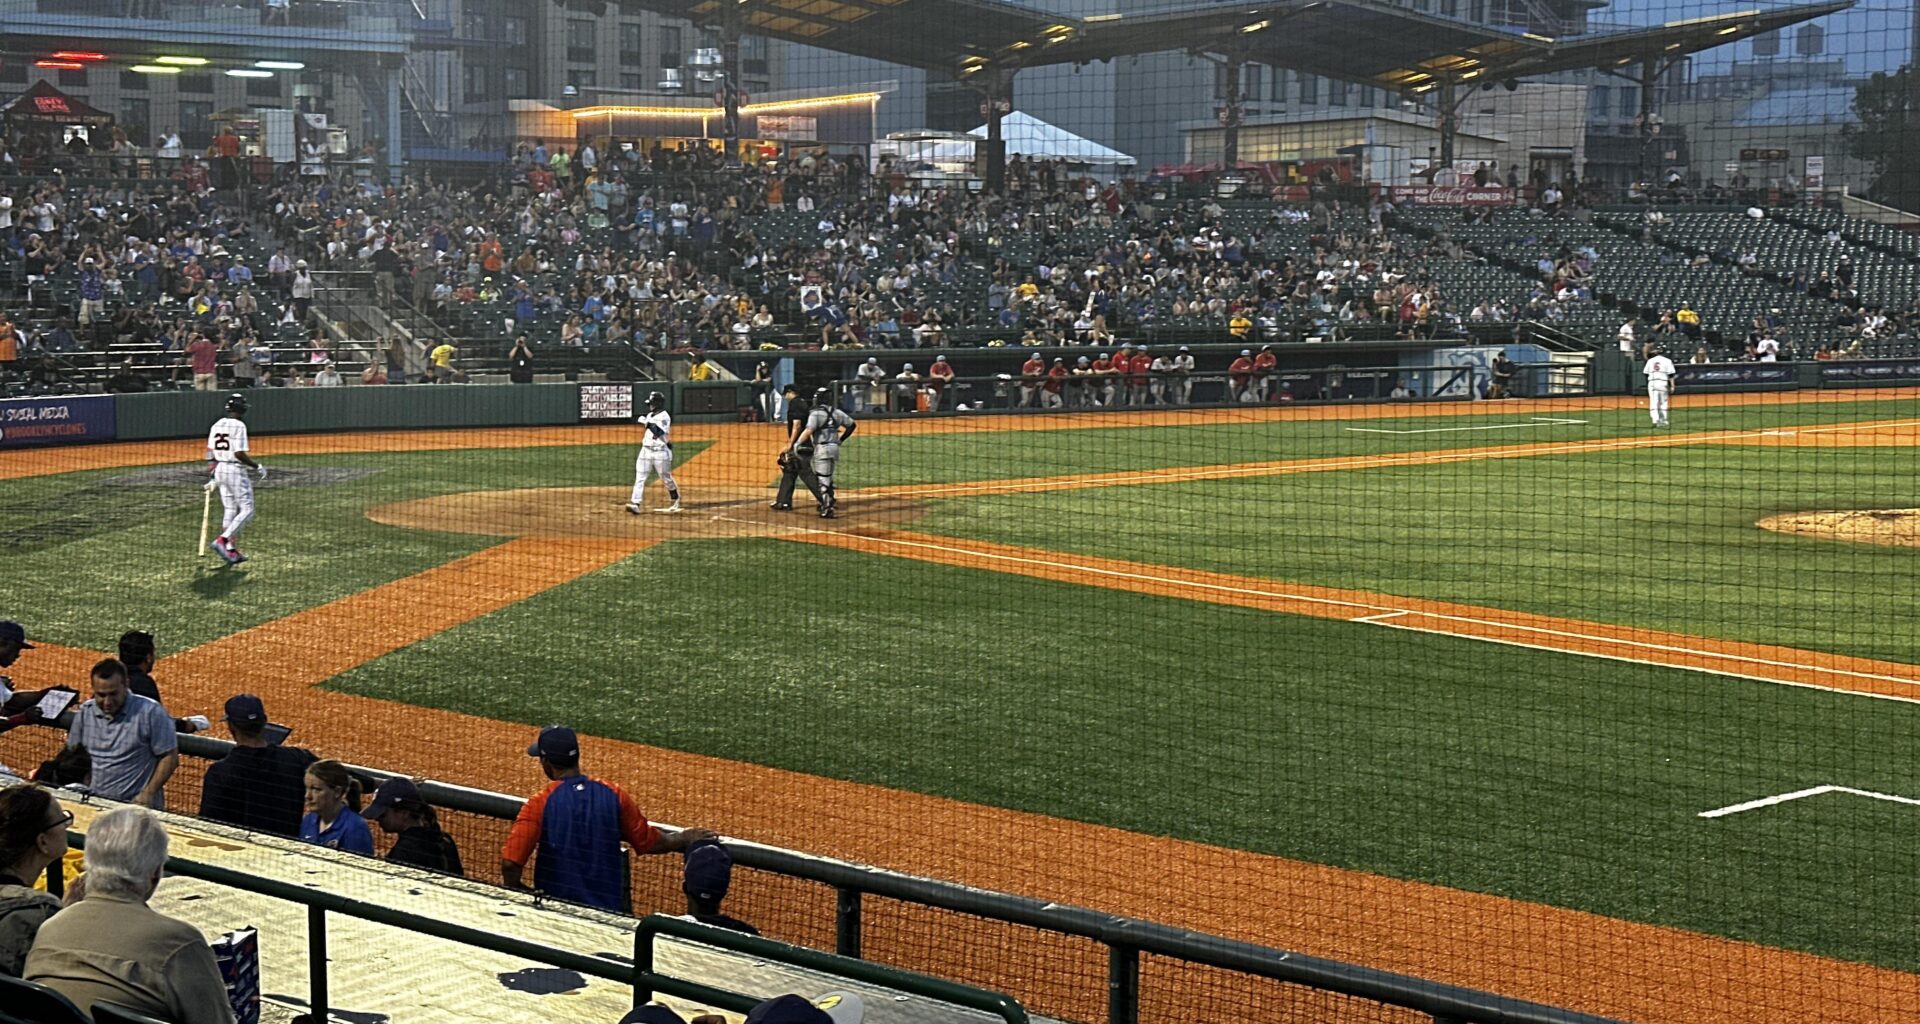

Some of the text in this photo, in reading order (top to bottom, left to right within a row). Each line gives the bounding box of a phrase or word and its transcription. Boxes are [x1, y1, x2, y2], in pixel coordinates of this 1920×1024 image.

[1466, 192, 1501, 201] CORNER
[6, 407, 38, 421] SOCIAL
[39, 405, 70, 420] MEDIA
[214, 433, 230, 451] 25
